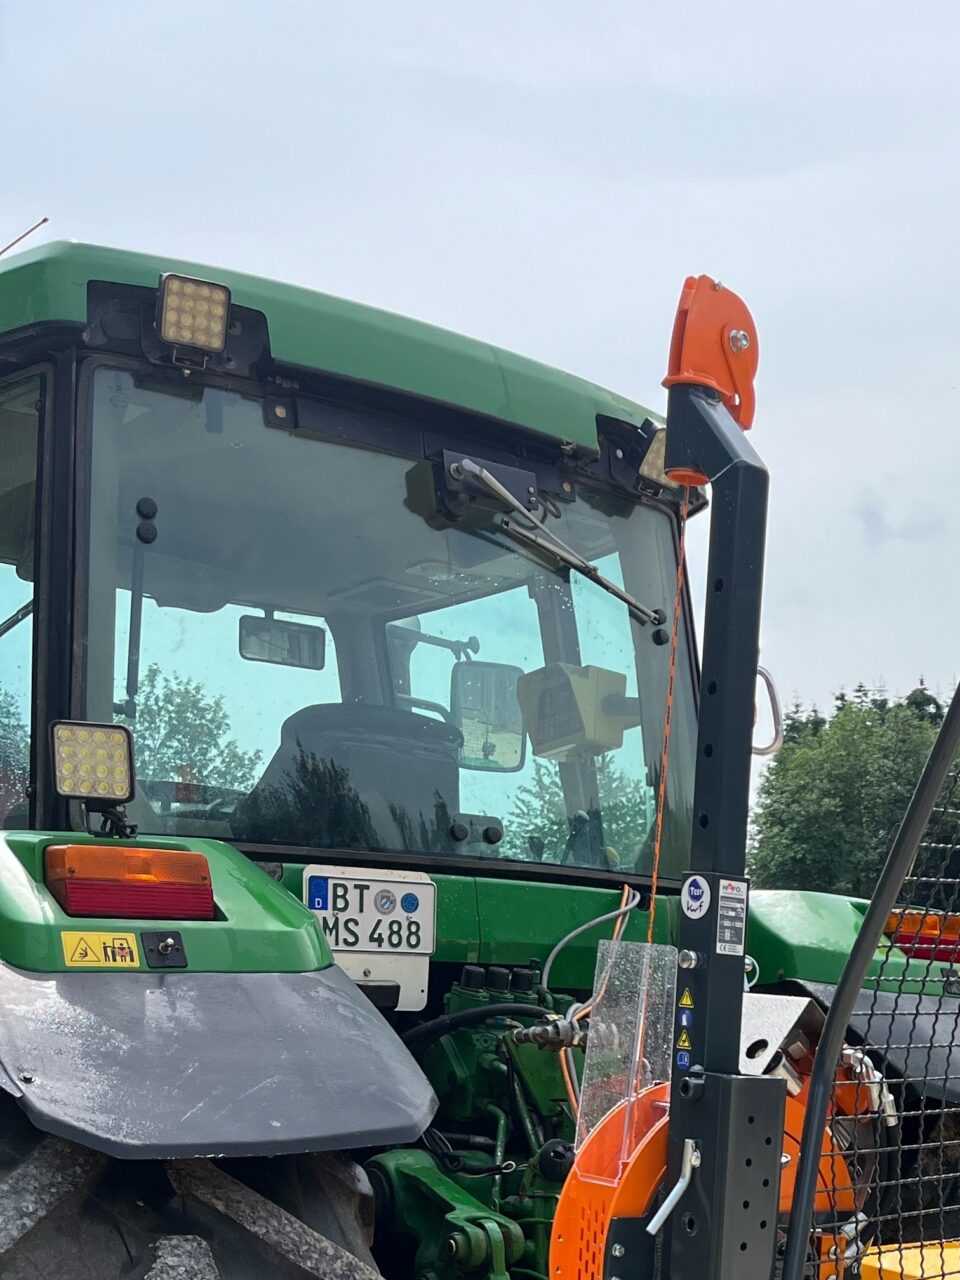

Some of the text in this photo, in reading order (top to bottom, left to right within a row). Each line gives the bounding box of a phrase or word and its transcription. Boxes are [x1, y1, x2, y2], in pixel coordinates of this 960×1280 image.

[332, 882, 370, 913] BT
[322, 916, 421, 949] MS 488
